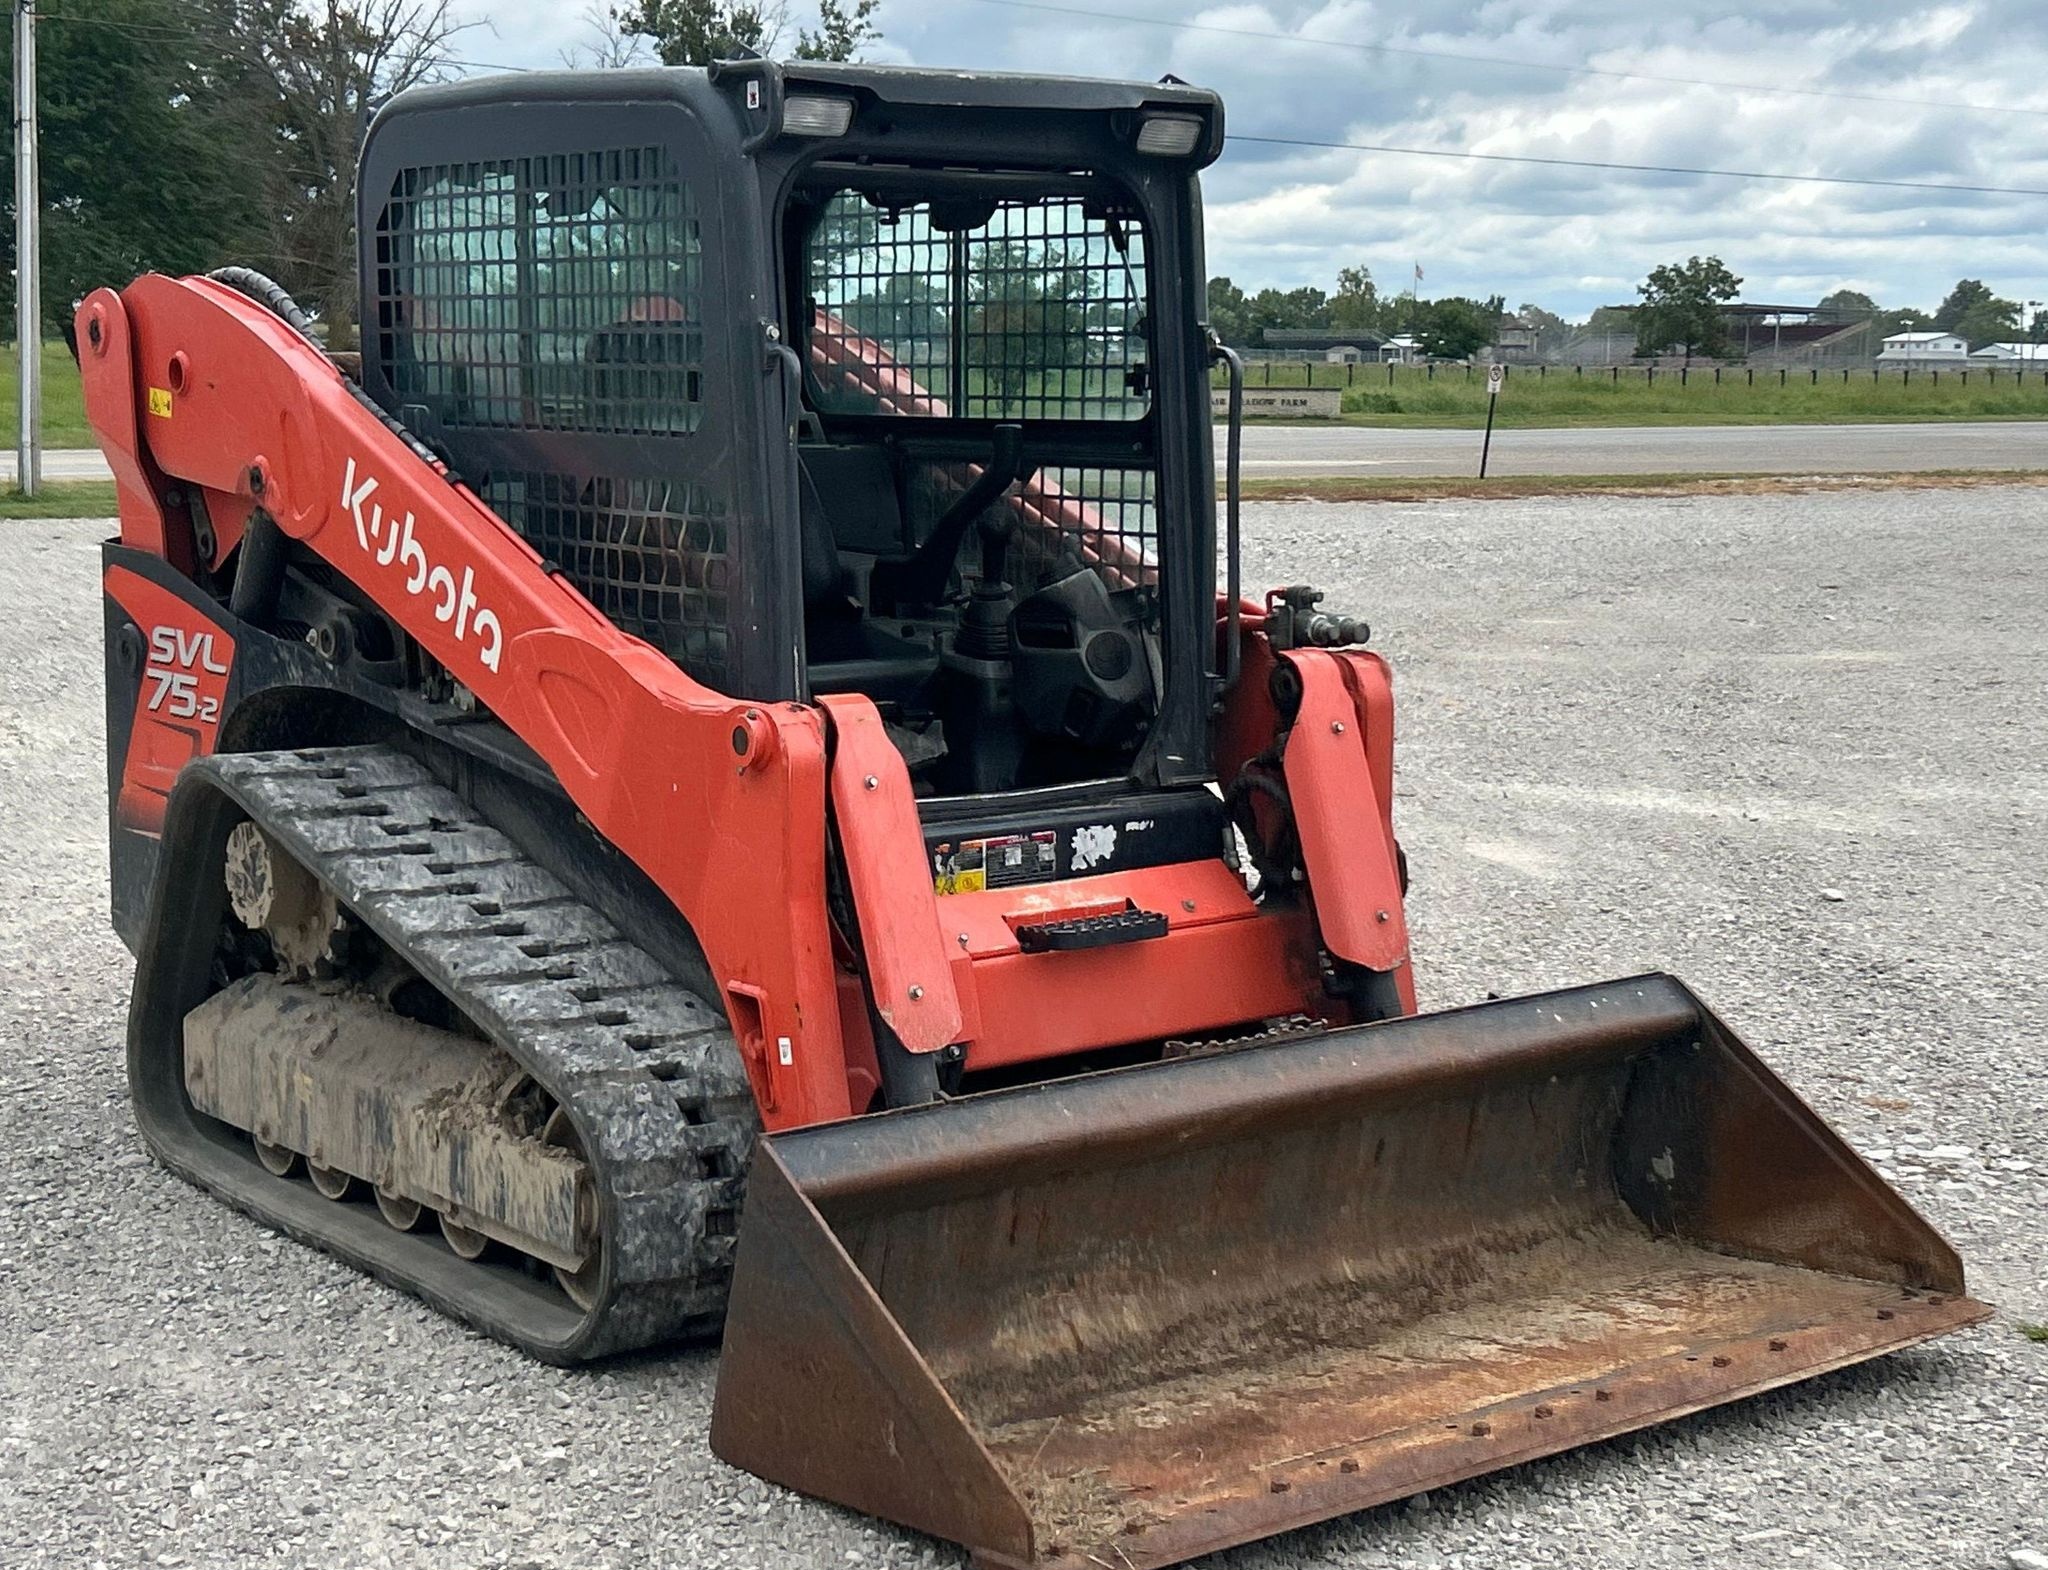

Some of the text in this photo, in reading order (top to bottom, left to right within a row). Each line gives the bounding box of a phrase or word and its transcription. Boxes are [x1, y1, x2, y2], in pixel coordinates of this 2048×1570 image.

[1281, 398, 1308, 406] FARM
[341, 457, 503, 674] Kubota
[150, 625, 228, 675] SVL
